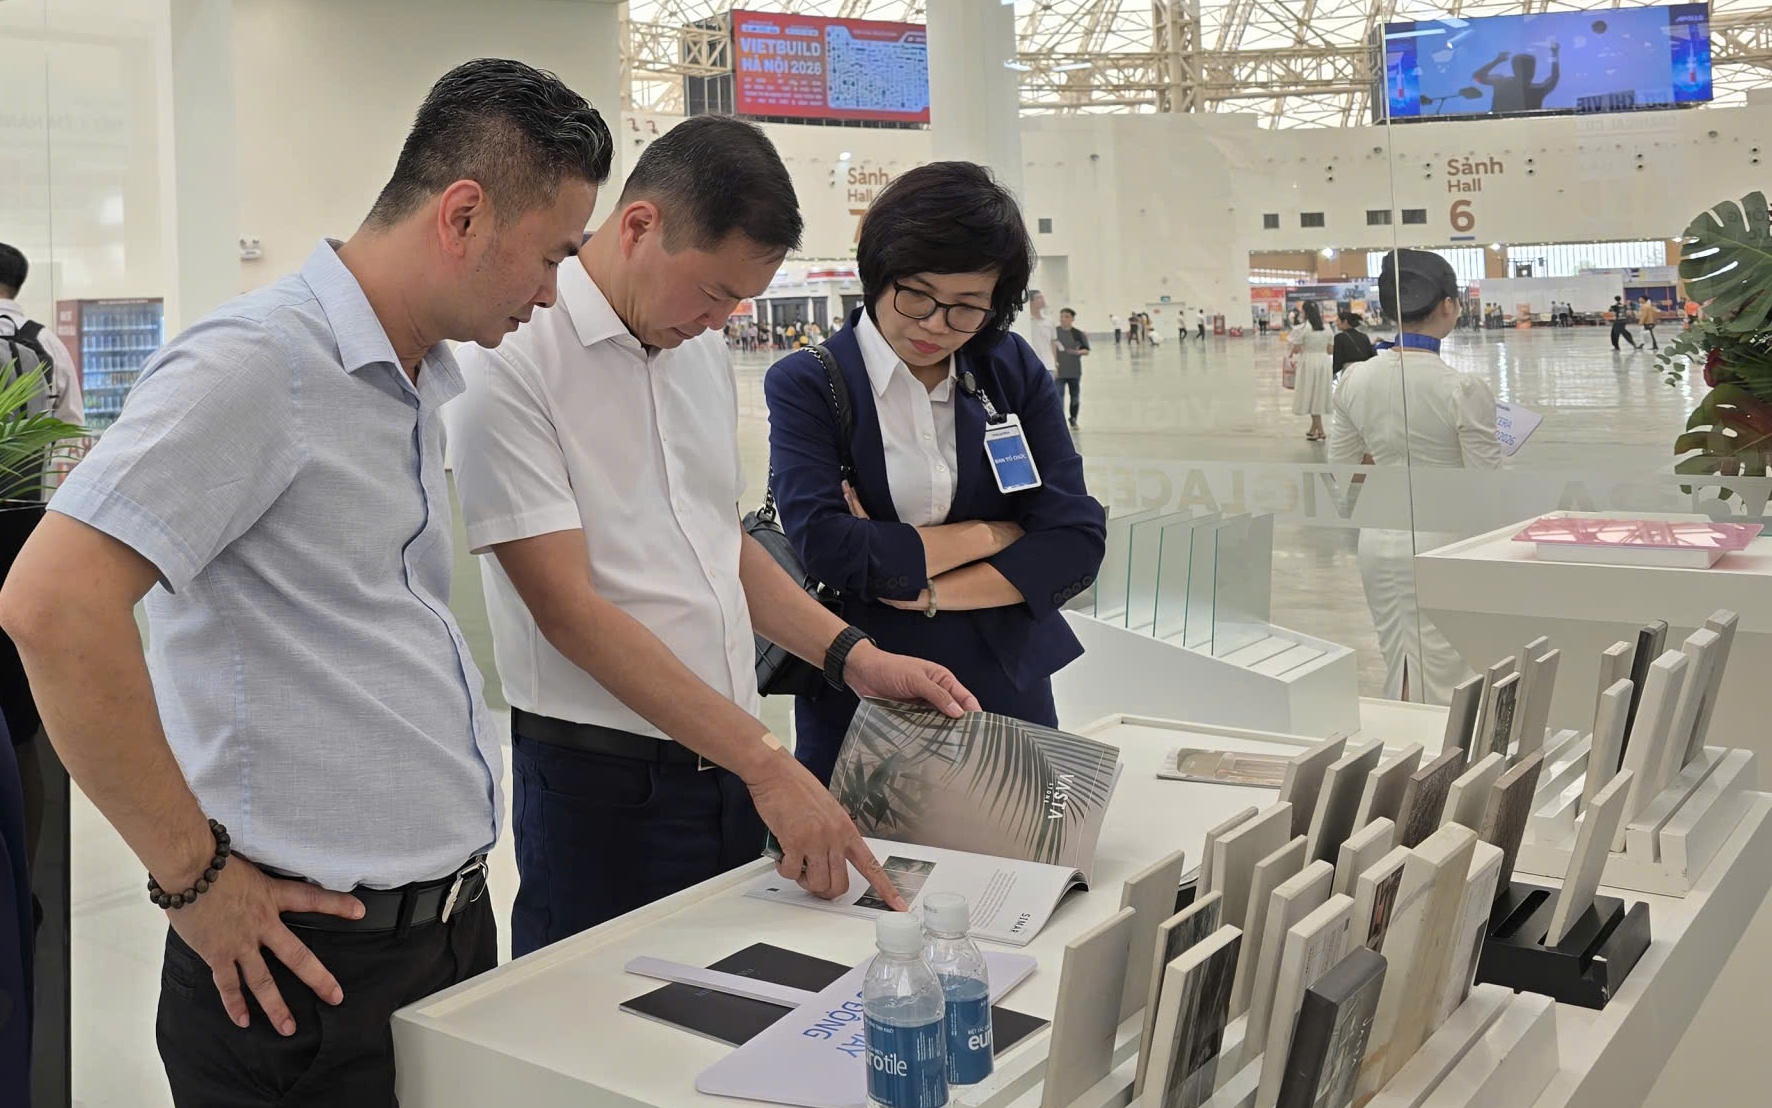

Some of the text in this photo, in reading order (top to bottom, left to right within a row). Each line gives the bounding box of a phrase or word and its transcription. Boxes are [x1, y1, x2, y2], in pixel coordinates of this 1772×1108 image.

[740, 37, 821, 57] VIETBUILD
[741, 54, 762, 72] HÀ
[763, 56, 789, 77] NỘI
[847, 166, 889, 186] Sảnh
[1447, 156, 1504, 176] Sảnh
[847, 189, 873, 202] Hall
[1447, 177, 1482, 193] Hall
[848, 209, 867, 243] 7
[1449, 199, 1476, 232] 6
[1047, 774, 1075, 819] VASTA
[866, 1050, 908, 1077] rotile
